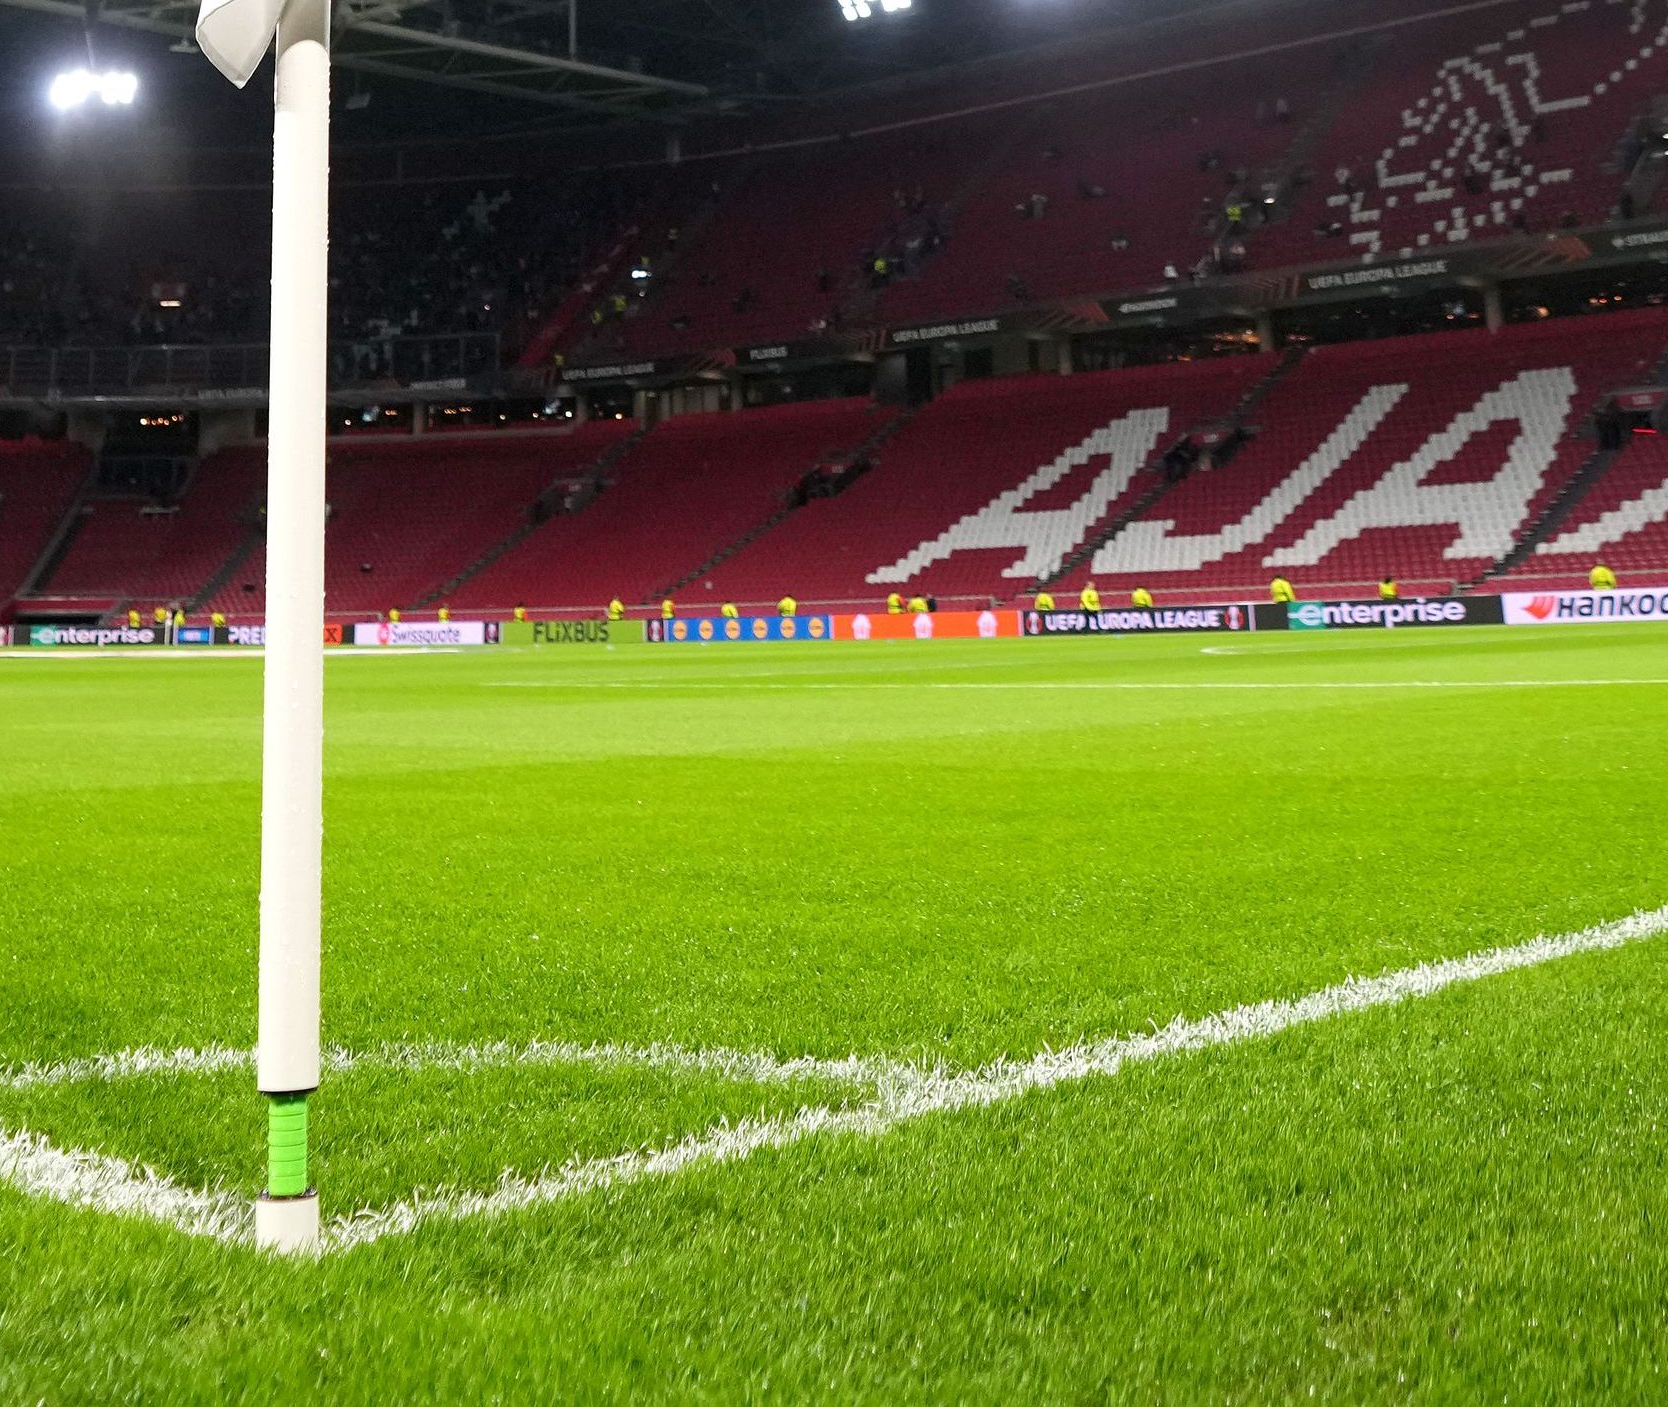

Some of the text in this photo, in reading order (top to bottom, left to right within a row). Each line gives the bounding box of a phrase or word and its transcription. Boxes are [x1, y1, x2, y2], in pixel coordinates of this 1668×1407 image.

[1155, 609, 1221, 629] LEAGUE
[1289, 597, 1467, 628] enterprise
[31, 624, 156, 648] enterprise
[391, 622, 461, 645] Swissquote
